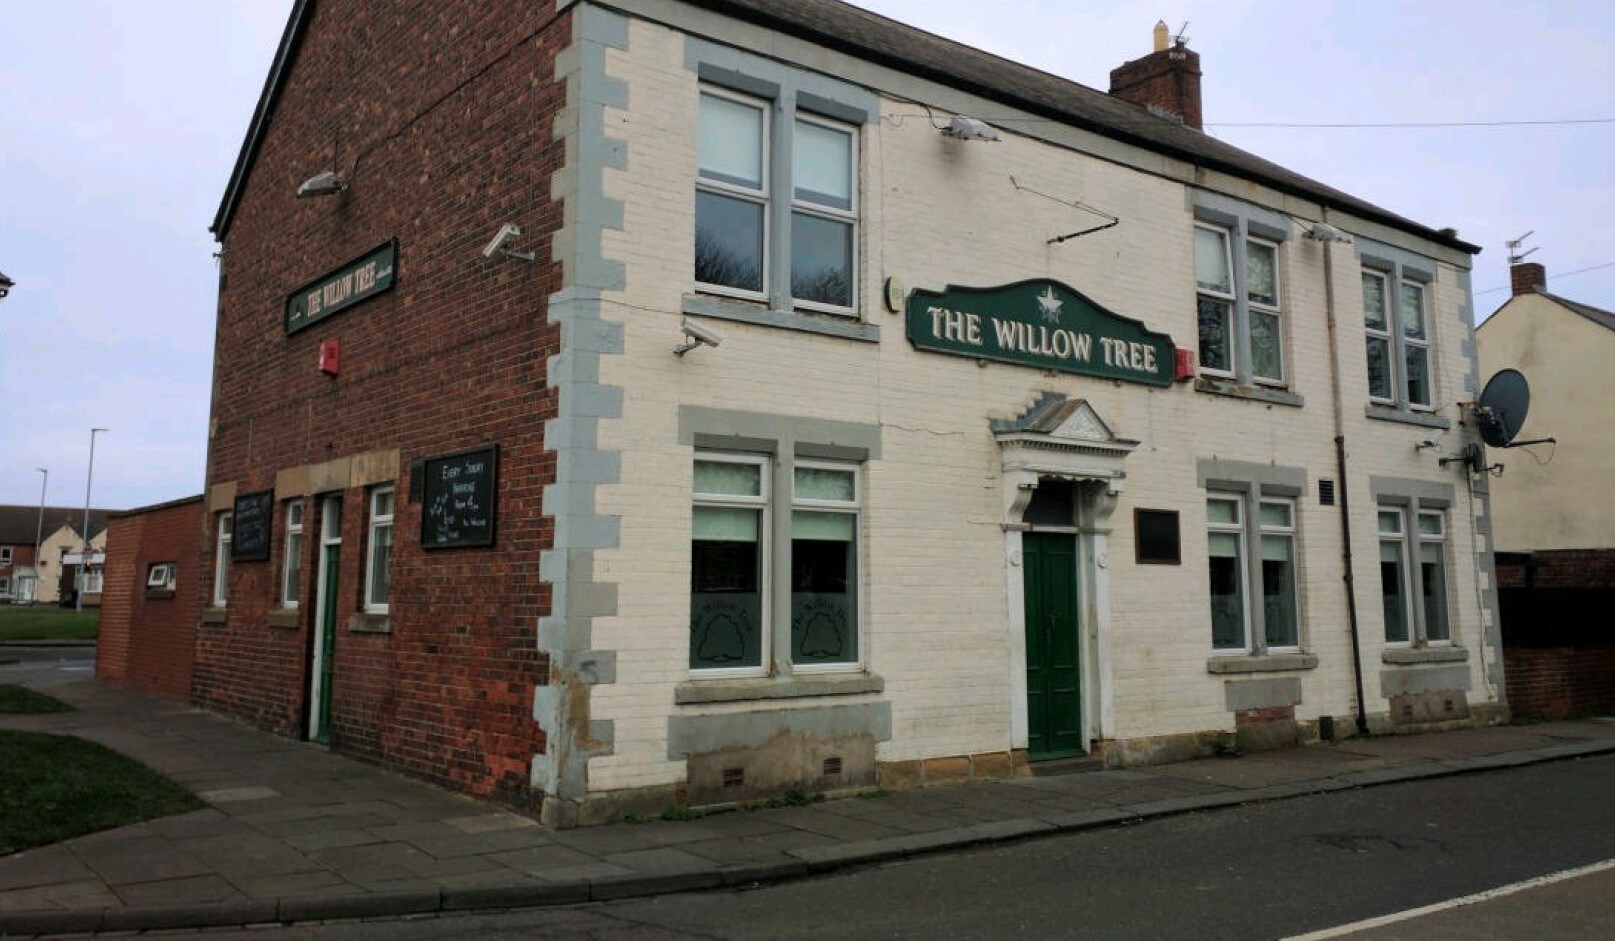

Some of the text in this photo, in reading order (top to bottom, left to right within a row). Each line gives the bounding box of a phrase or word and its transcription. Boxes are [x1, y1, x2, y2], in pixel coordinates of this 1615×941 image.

[308, 288, 321, 317] THE
[323, 273, 353, 309] WILLOW
[355, 261, 376, 295] TREE
[927, 306, 1160, 374] THE WILLOW TREE
